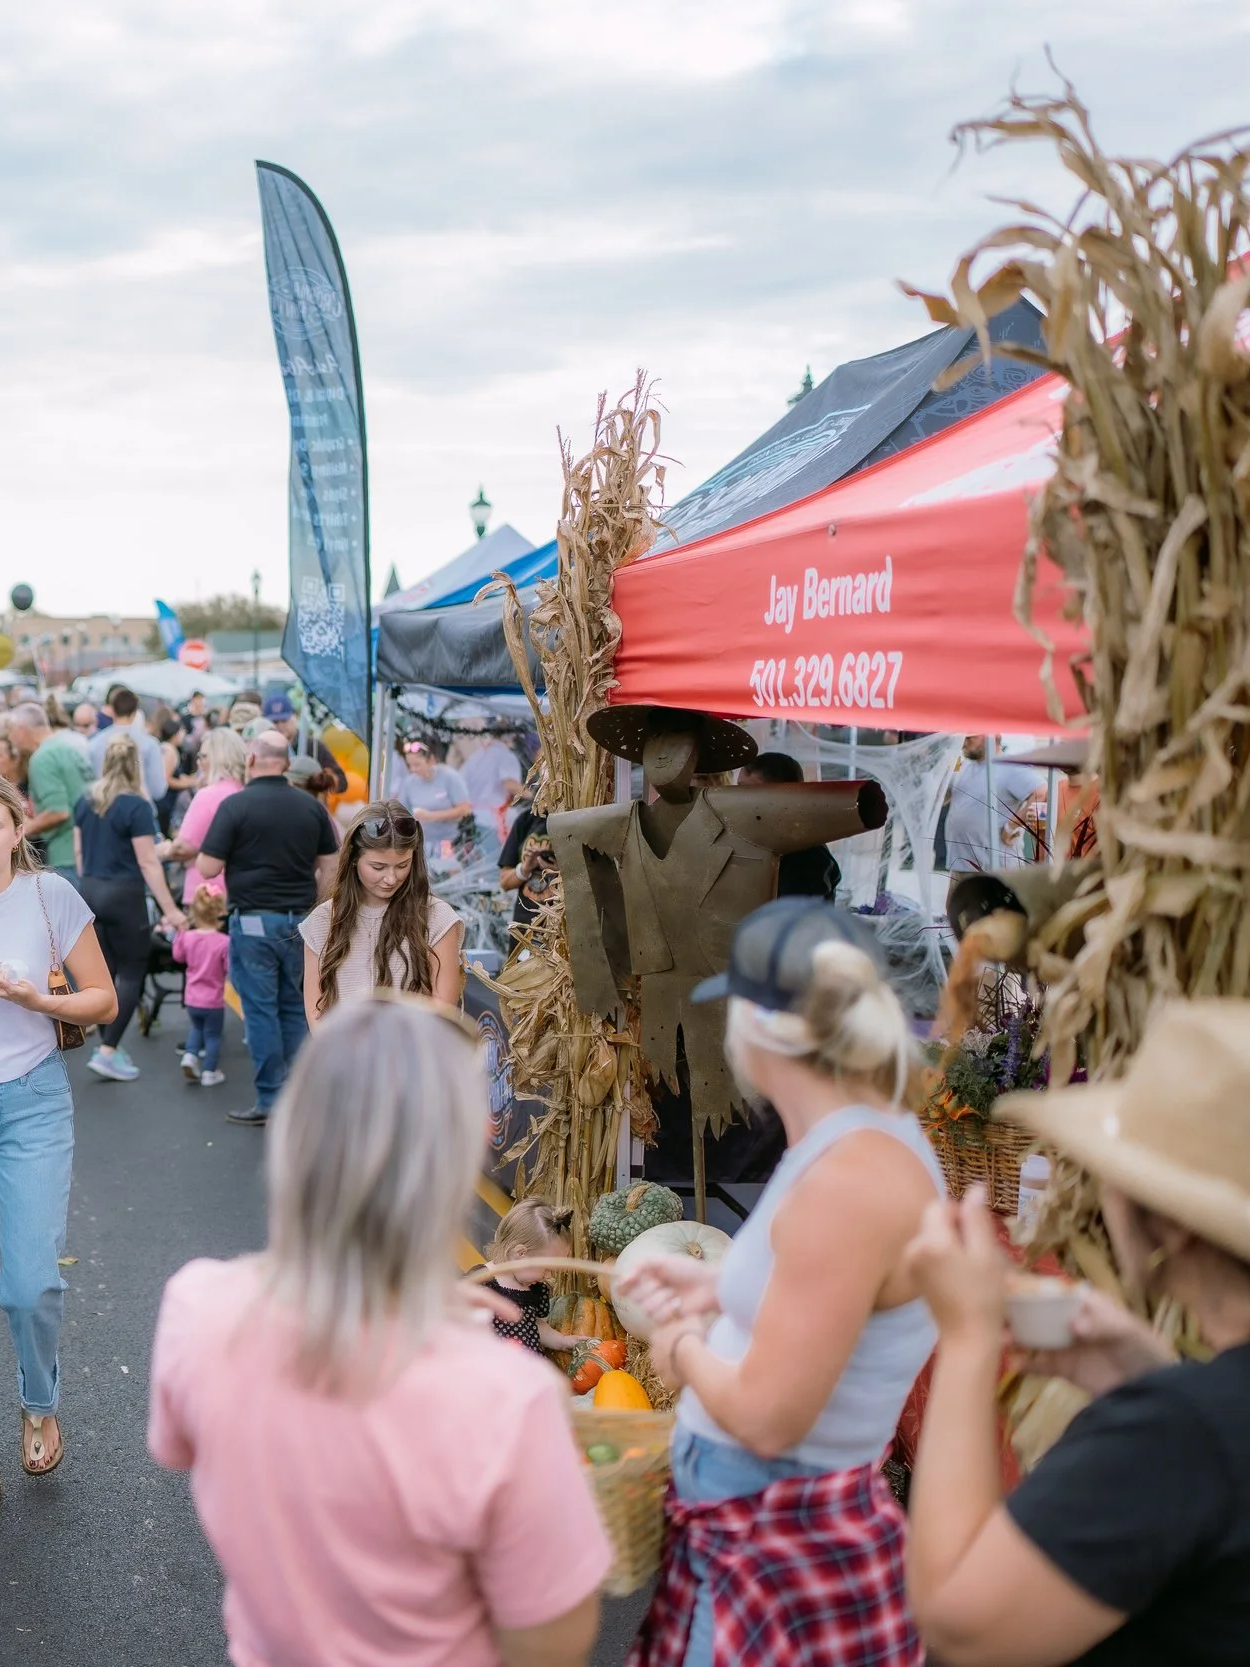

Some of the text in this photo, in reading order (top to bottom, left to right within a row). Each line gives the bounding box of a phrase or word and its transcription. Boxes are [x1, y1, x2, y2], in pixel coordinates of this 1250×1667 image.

[764, 555, 893, 634] Jay Bernard
[750, 651, 903, 709] 501.329.6827
